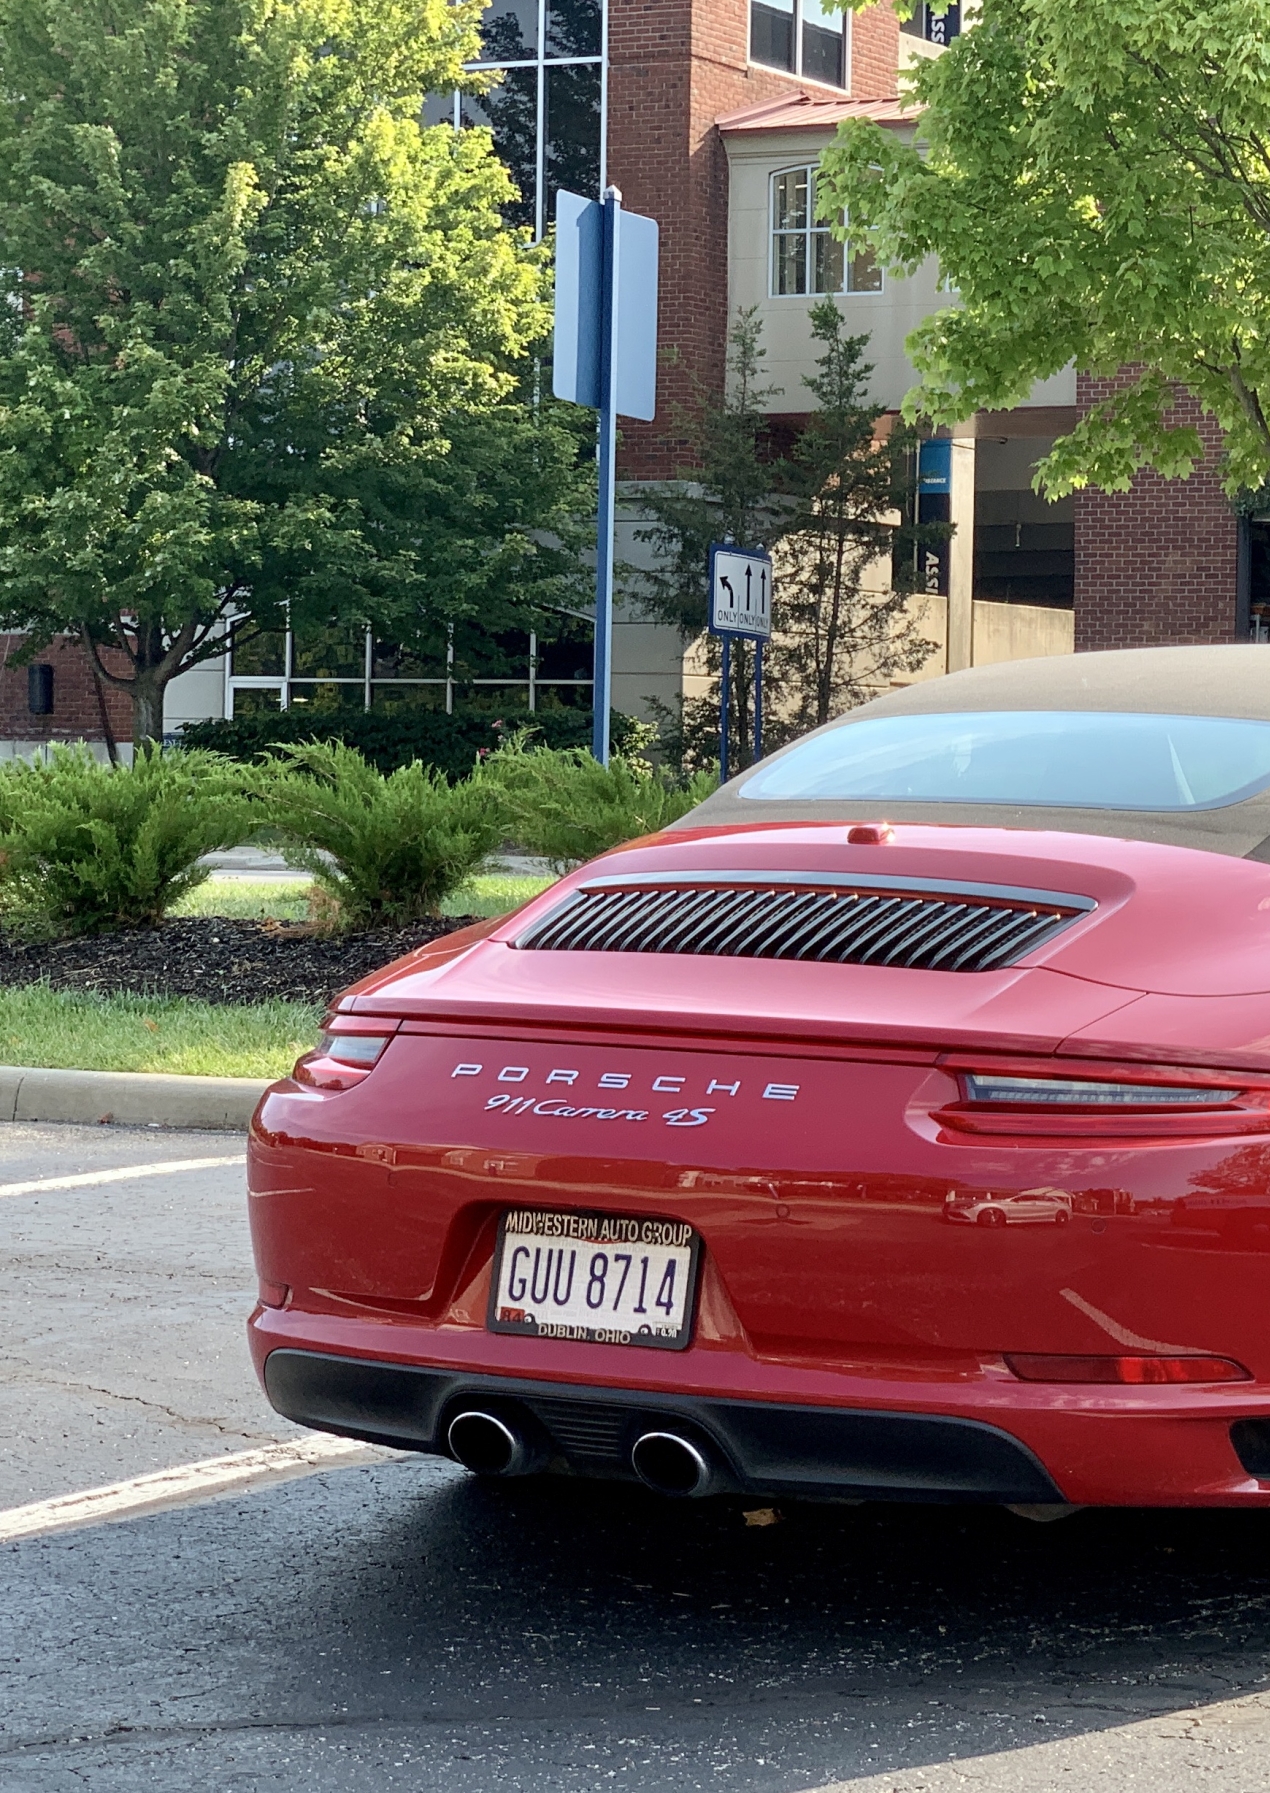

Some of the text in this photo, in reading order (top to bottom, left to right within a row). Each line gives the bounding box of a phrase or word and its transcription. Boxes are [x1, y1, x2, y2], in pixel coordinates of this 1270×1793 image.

[718, 609, 738, 623] ONLY
[740, 613, 755, 626] ONLY
[757, 616, 768, 629] ONLY
[451, 1063, 800, 1100] PORSCHE
[484, 1094, 716, 1127] 911 Carrera 4S
[505, 1211, 693, 1247] MIDWESTERN AUTO GROUP
[508, 1245, 677, 1316] GUU 8714
[595, 1328, 631, 1344] OHIO
